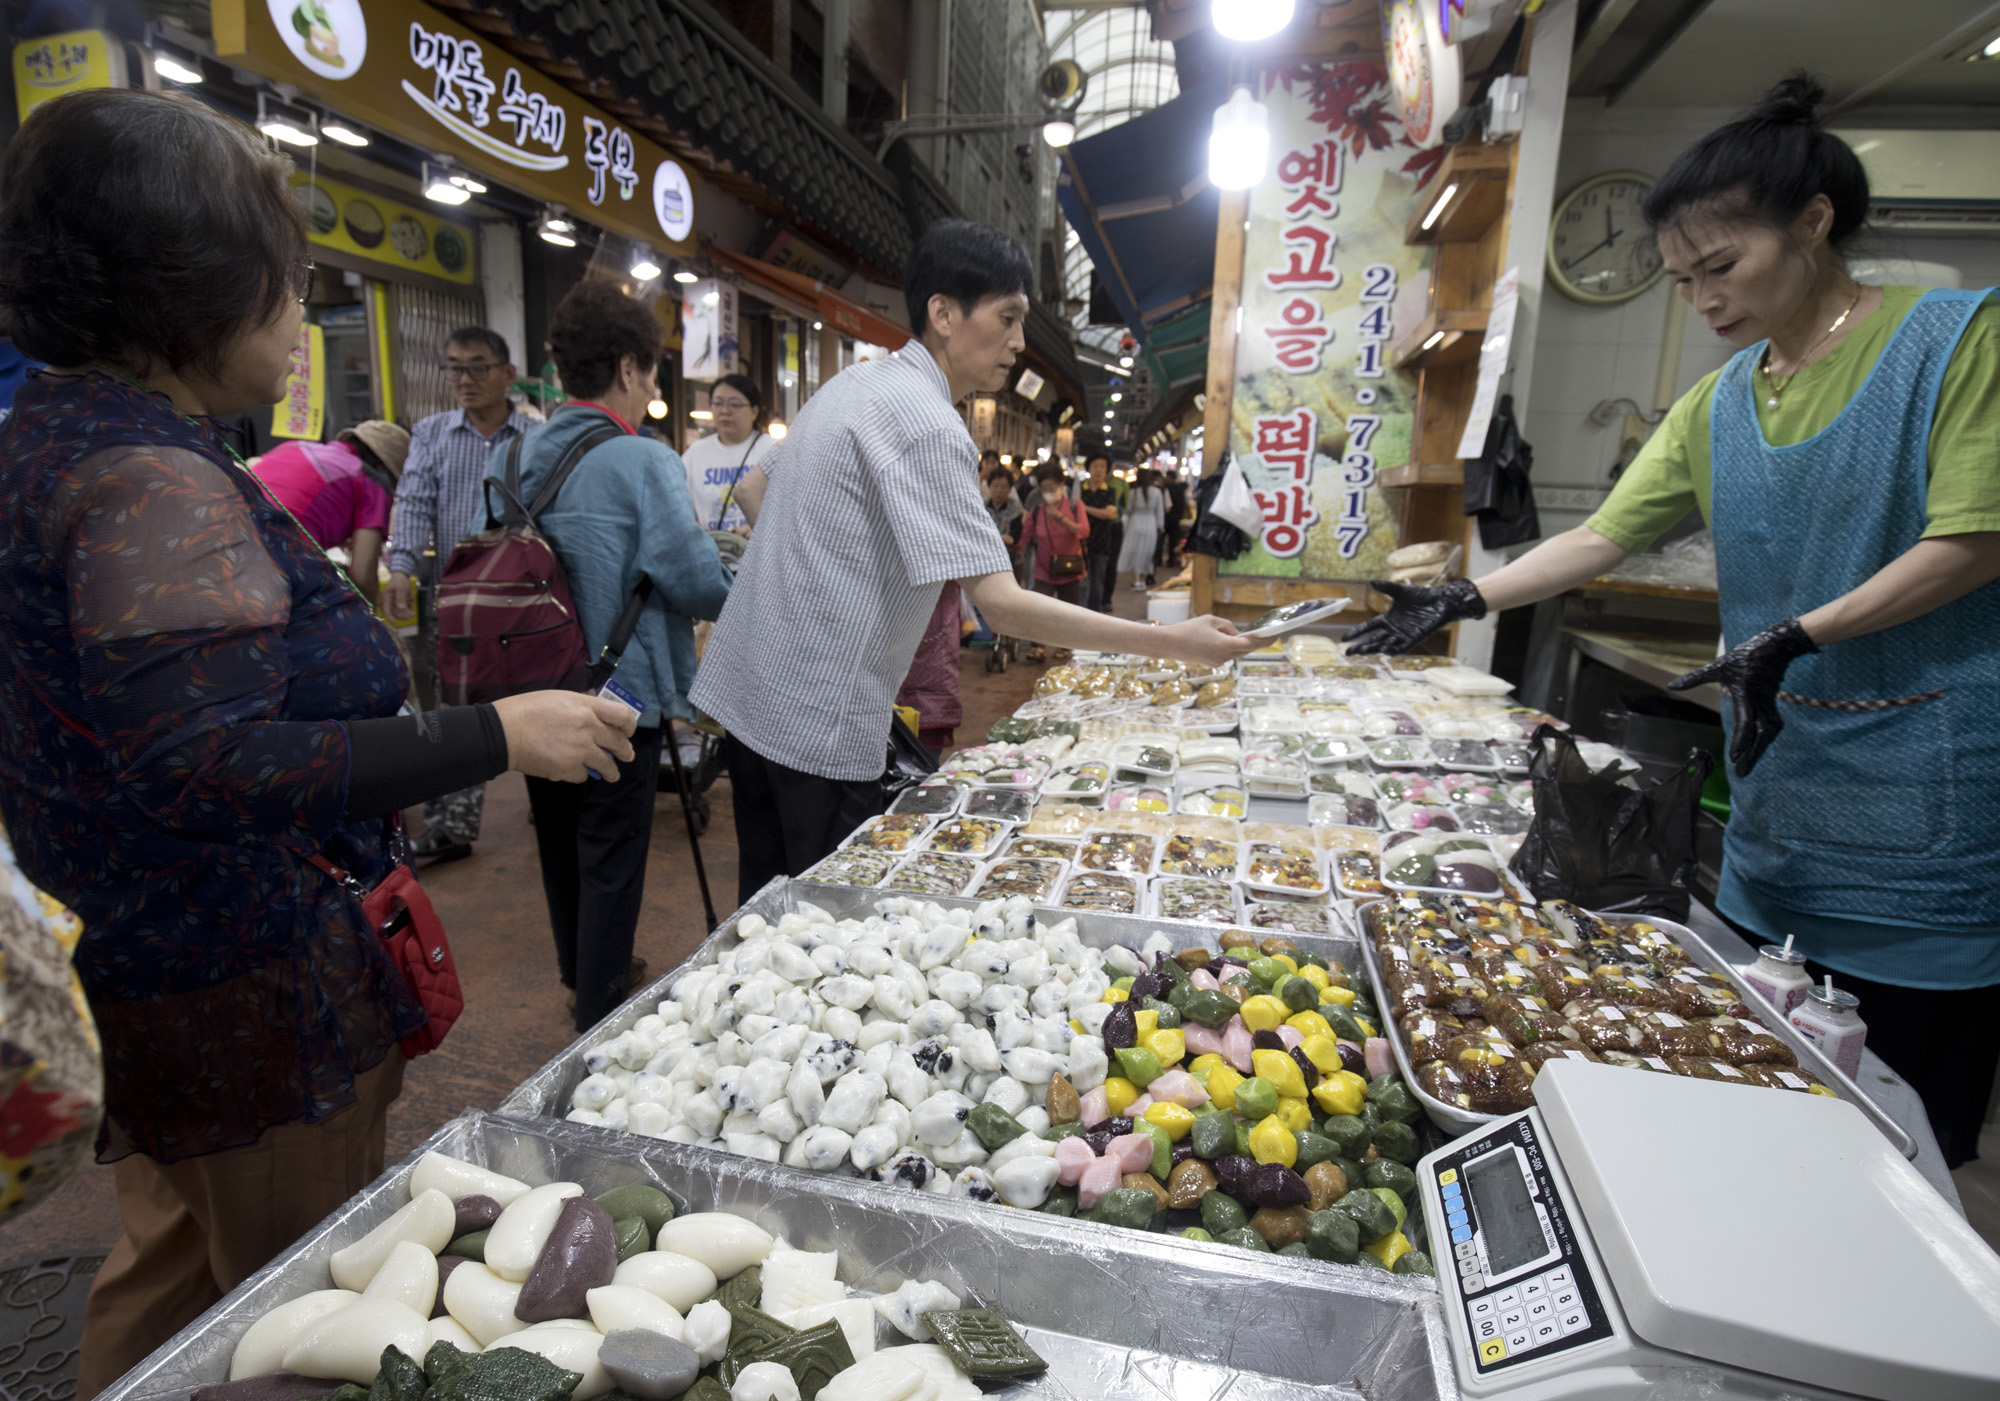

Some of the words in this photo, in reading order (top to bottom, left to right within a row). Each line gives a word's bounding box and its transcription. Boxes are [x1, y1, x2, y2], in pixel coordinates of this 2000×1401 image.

[410, 22, 495, 127] 맷돌
[498, 68, 566, 152] 수제
[583, 116, 639, 205] 두부
[1608, 186, 1626, 199] 12
[1264, 138, 1339, 369] 옛고을
[1253, 411, 1313, 553] 떡방
[1517, 1121, 1533, 1144] ACOM
[1527, 1145, 1543, 1171] PC-500
[1552, 1273, 1565, 1282] 7
[1527, 1285, 1539, 1294] 4
[1559, 1294, 1572, 1304] 8
[1476, 1304, 1489, 1312] 0
[1533, 1305, 1546, 1314] 5
[1507, 1315, 1520, 1325] 2
[1566, 1315, 1580, 1325] 9
[1480, 1321, 1495, 1337] 00
[1539, 1326, 1553, 1336] 6
[1512, 1336, 1525, 1345] 3
[1486, 1345, 1499, 1356] C
